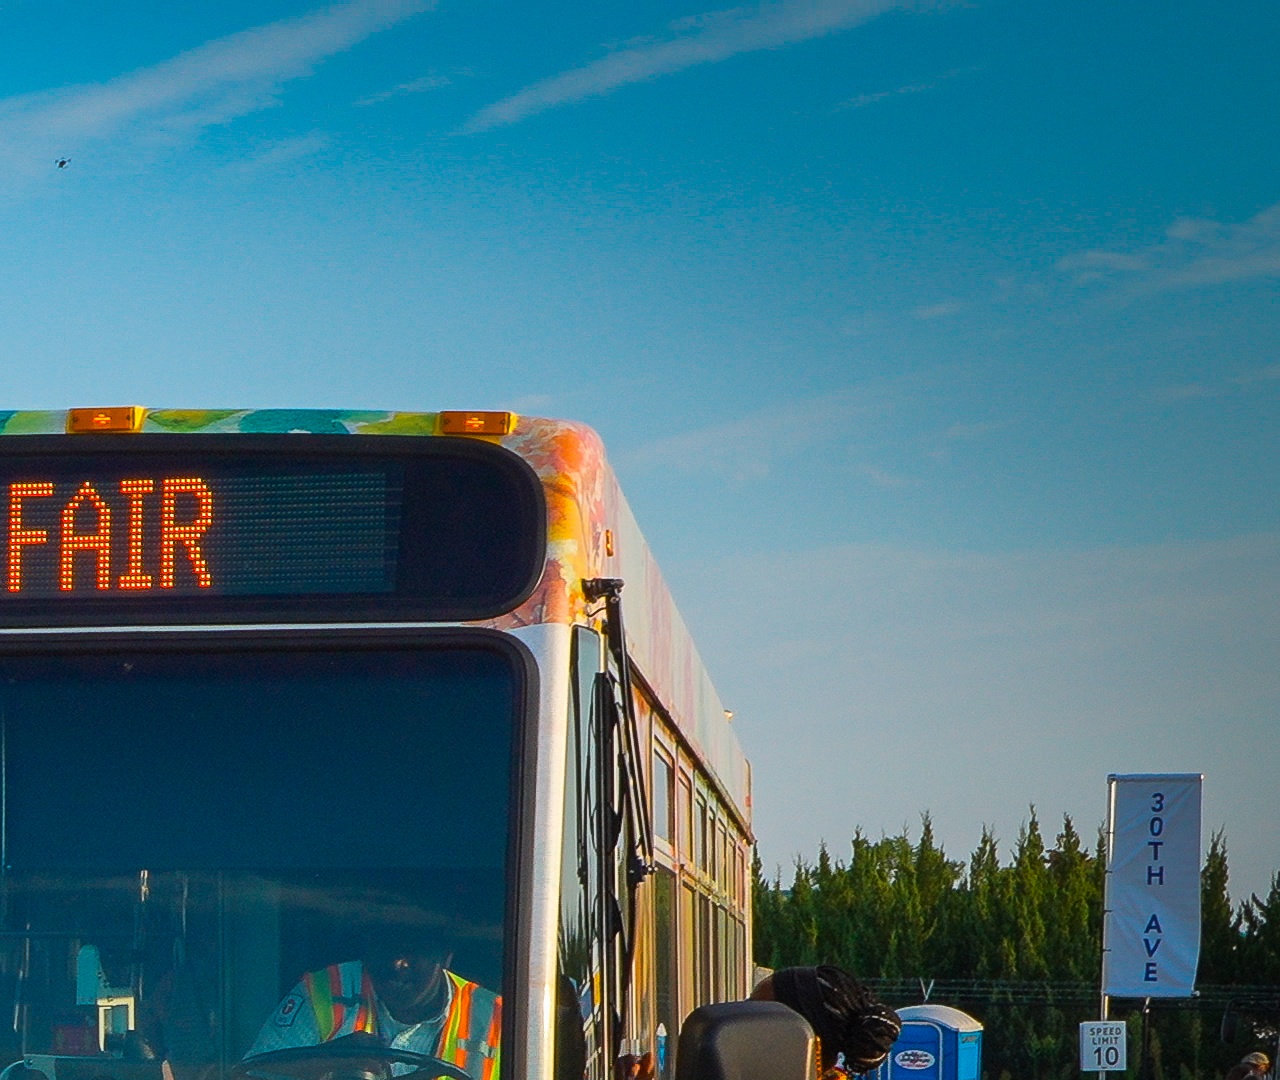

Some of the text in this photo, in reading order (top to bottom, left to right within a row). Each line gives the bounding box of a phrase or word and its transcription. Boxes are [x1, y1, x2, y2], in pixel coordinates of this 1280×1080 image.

[7, 478, 213, 592] FAIR
[1143, 792, 1165, 982] 30TH AVE
[1090, 1027, 1122, 1036] SPEED
[1092, 1036, 1119, 1045] LIMIT
[1094, 1046, 1119, 1066] 10
